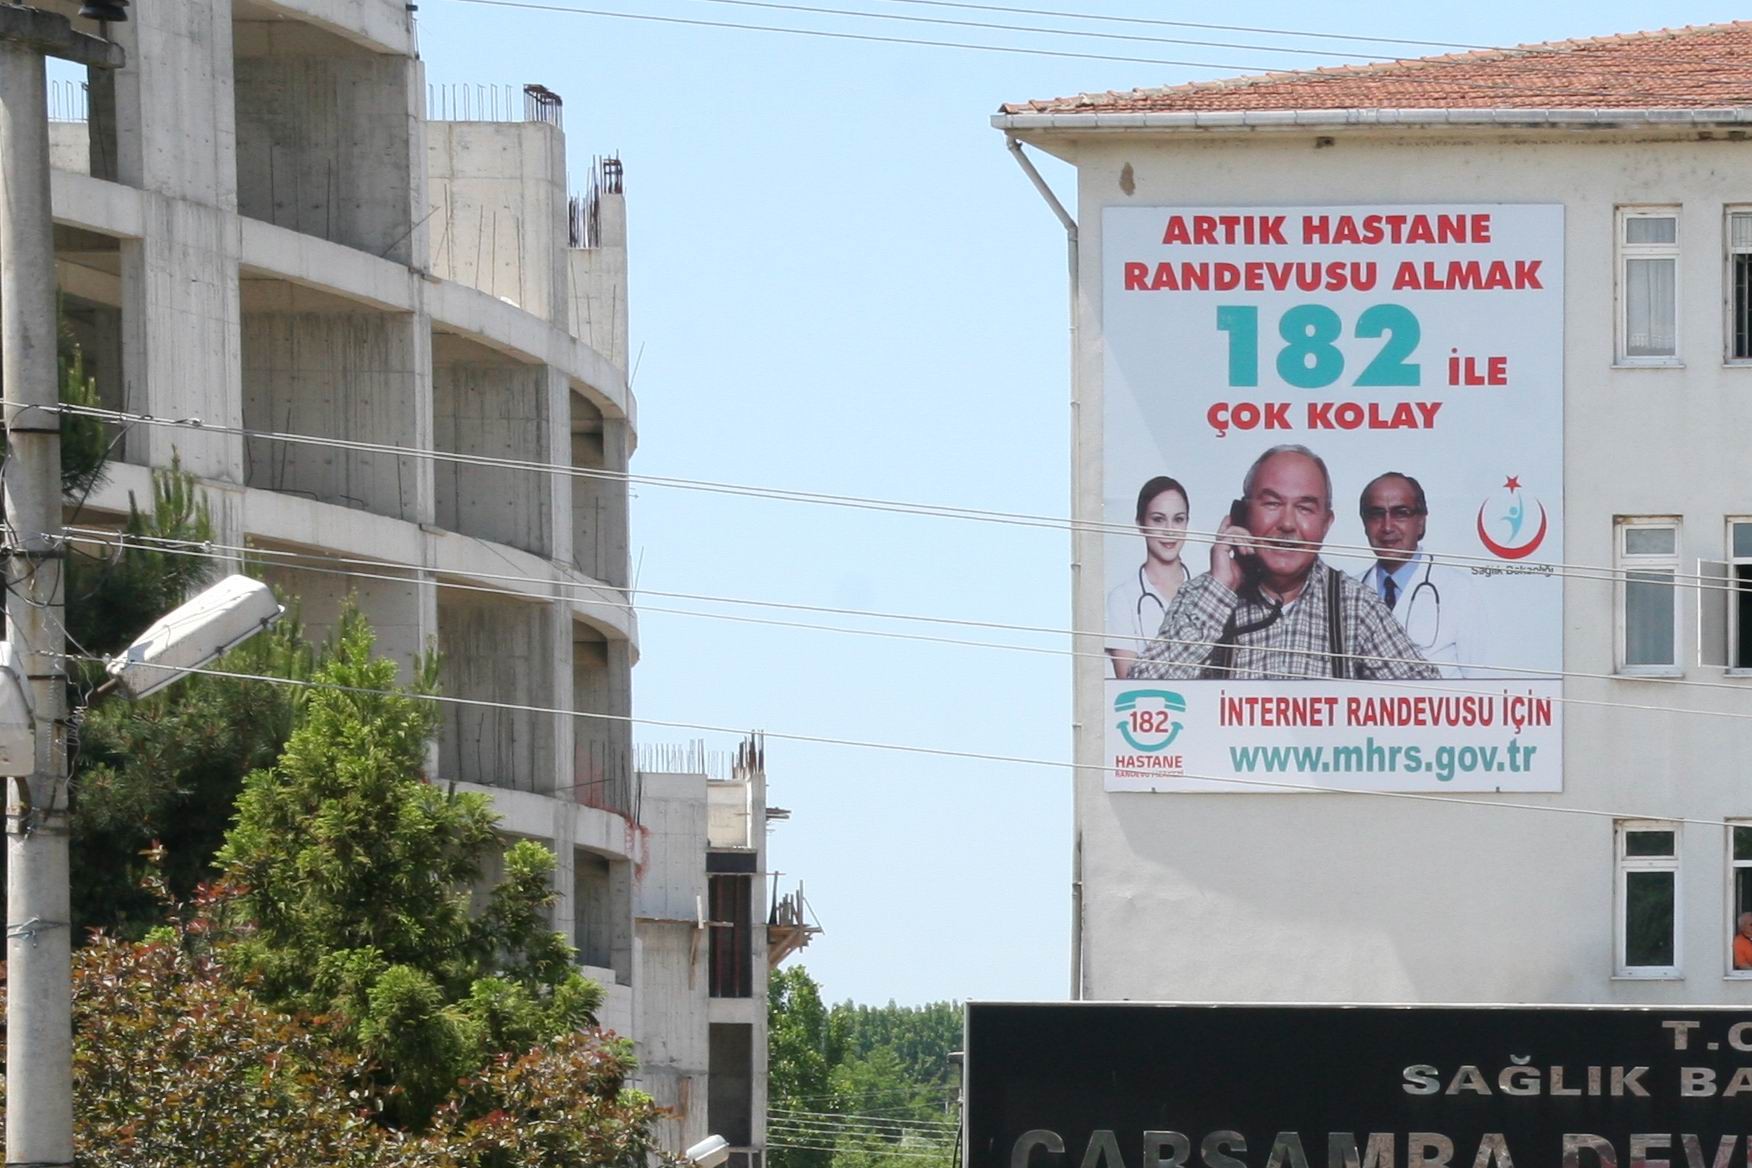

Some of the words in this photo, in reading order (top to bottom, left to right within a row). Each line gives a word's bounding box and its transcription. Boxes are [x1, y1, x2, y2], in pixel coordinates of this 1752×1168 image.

[1162, 215, 1288, 245] ARTIK
[1302, 214, 1491, 245] HASTANE
[1124, 261, 1378, 291] RANDEVUSU
[1392, 260, 1543, 290] ALMAK
[1216, 303, 1422, 389] 182
[1448, 347, 1508, 386] İLE
[1206, 402, 1292, 438] ÇOK
[1307, 402, 1443, 430] KOLAY
[1129, 710, 1169, 733] 182
[1219, 689, 1338, 728] İNTERNET
[1347, 697, 1494, 727] RANDEVUSU
[1503, 689, 1553, 735] İÇİN
[1115, 755, 1183, 768] HASTANE
[1229, 737, 1537, 783] www.mhrs.gov.tr
[1401, 1053, 1652, 1097] SAĞLIK
